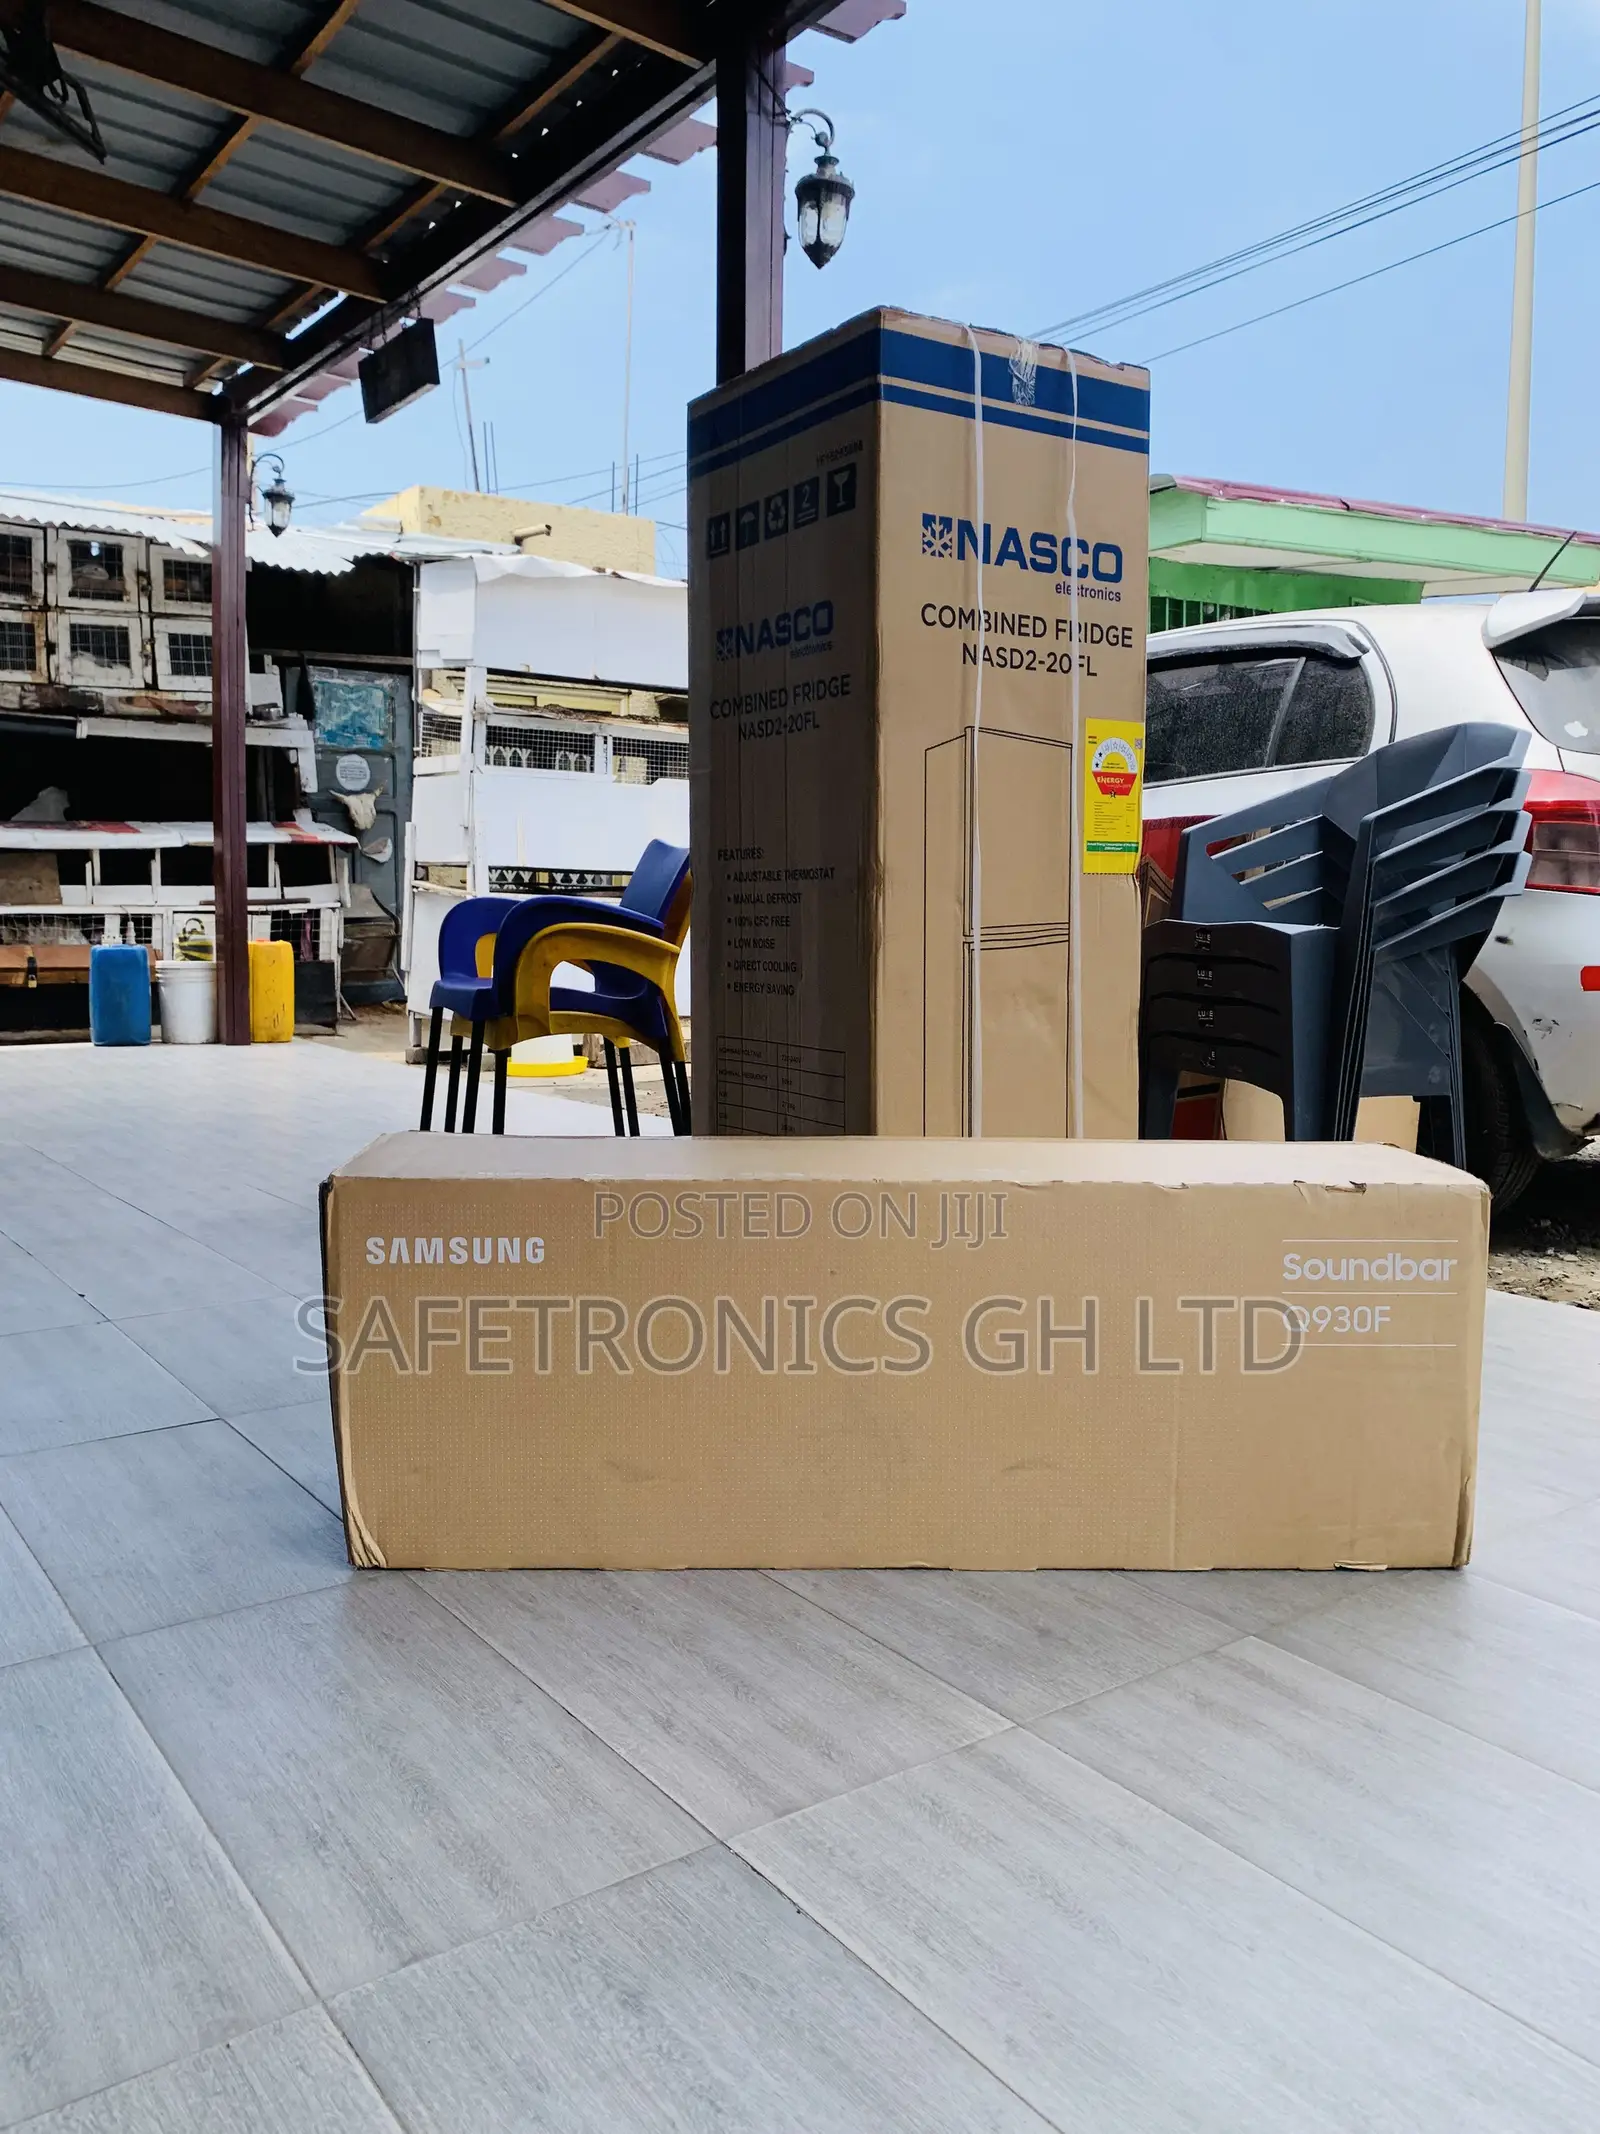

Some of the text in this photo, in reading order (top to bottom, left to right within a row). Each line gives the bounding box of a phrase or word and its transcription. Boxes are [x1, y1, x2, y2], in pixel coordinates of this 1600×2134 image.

[957, 518, 1123, 584] NASCO
[735, 600, 834, 659] NASCO
[921, 603, 1133, 649] COMBINED FRIDGE
[710, 674, 851, 721] COMBINED FRIDGE
[737, 711, 819, 743] NASD2-20FL
[1097, 775, 1124, 784] ENERGY
[717, 846, 765, 861] FEATURES:
[733, 867, 835, 883] ADJUSTABLE THERMOSTAT
[733, 893, 802, 905] MANUAL DEFROST
[770, 915, 791, 927] FREE
[733, 938, 776, 949] LOW NOISE
[733, 960, 797, 973] DIRECT COOLING
[733, 982, 795, 996] ENERGY SAVING
[366, 1236, 545, 1265] SAMSUNG
[1283, 1253, 1458, 1281] Soundbar
[1282, 1305, 1391, 1333] Q930F
